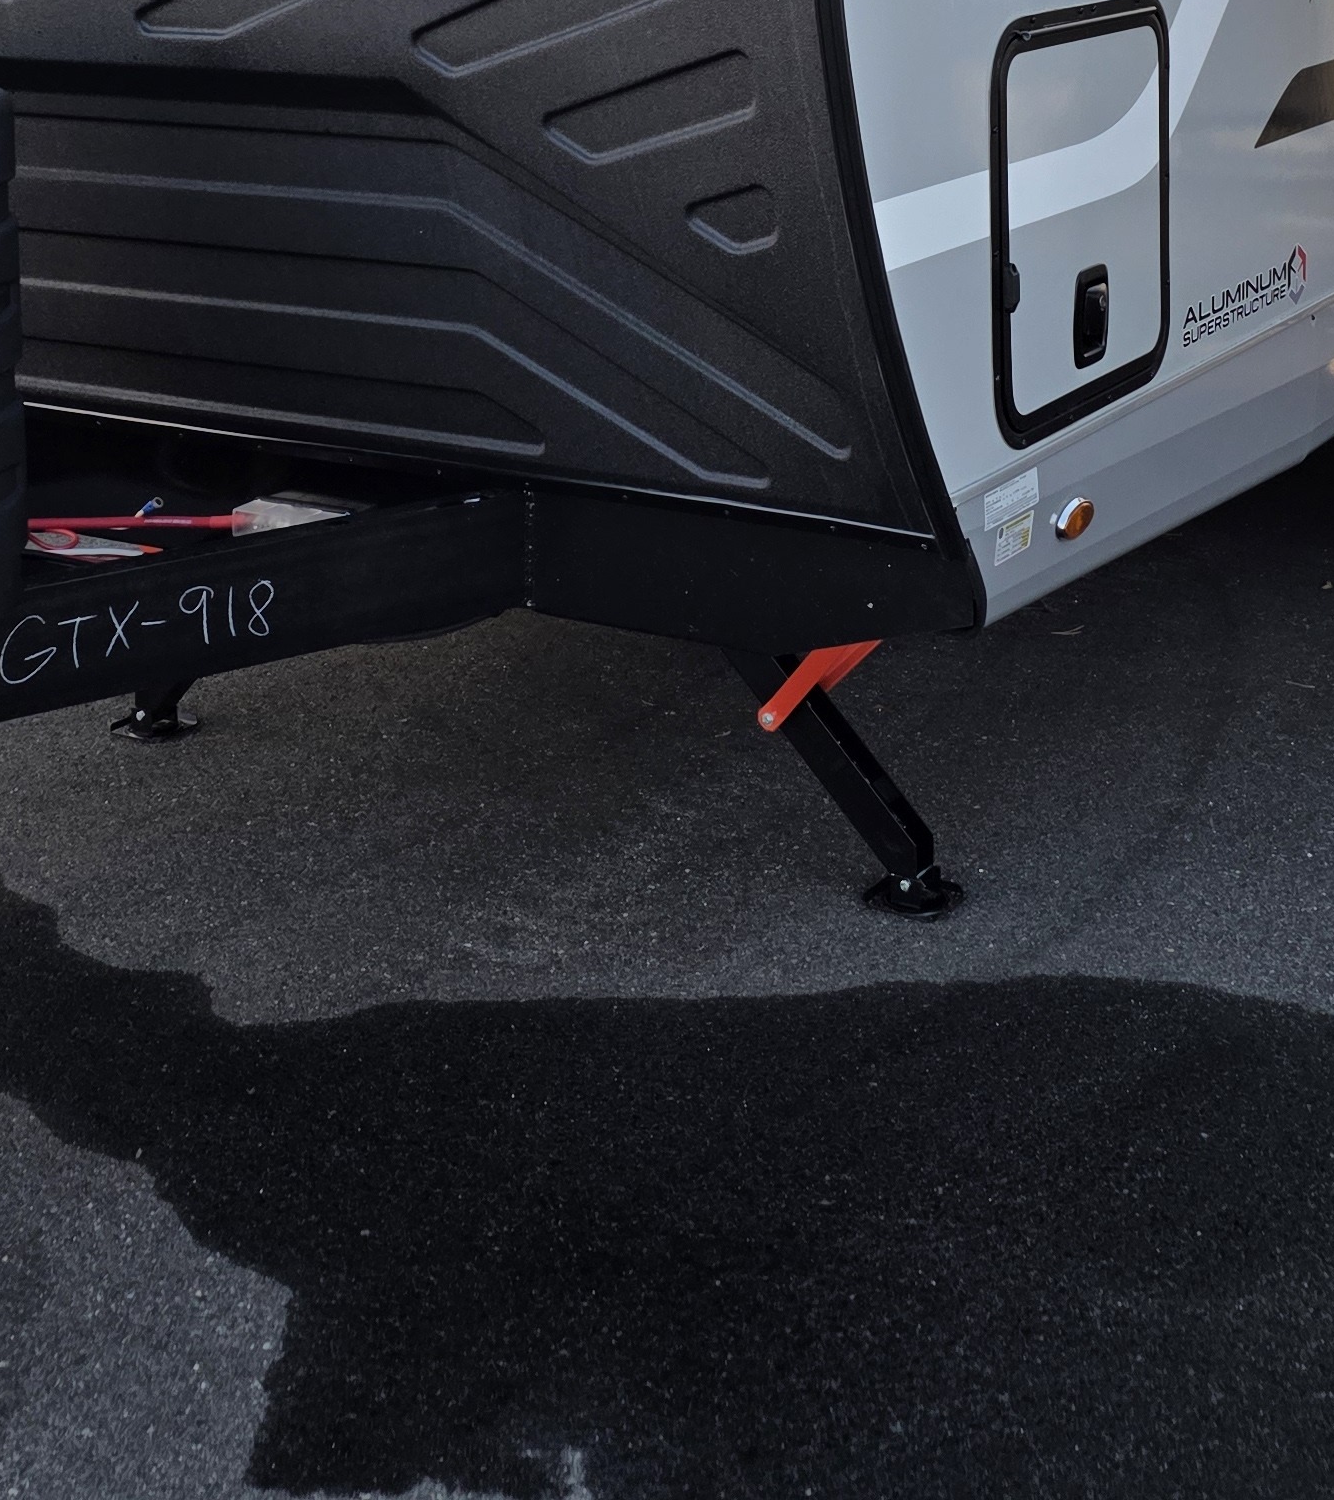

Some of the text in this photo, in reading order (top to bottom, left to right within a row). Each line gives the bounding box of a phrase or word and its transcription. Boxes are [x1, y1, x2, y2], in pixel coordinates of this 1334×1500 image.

[1182, 283, 1287, 348] SUPERSTRUCTURE
[1183, 261, 1287, 330] ALUMINUM
[0, 578, 274, 685] GTX-918
